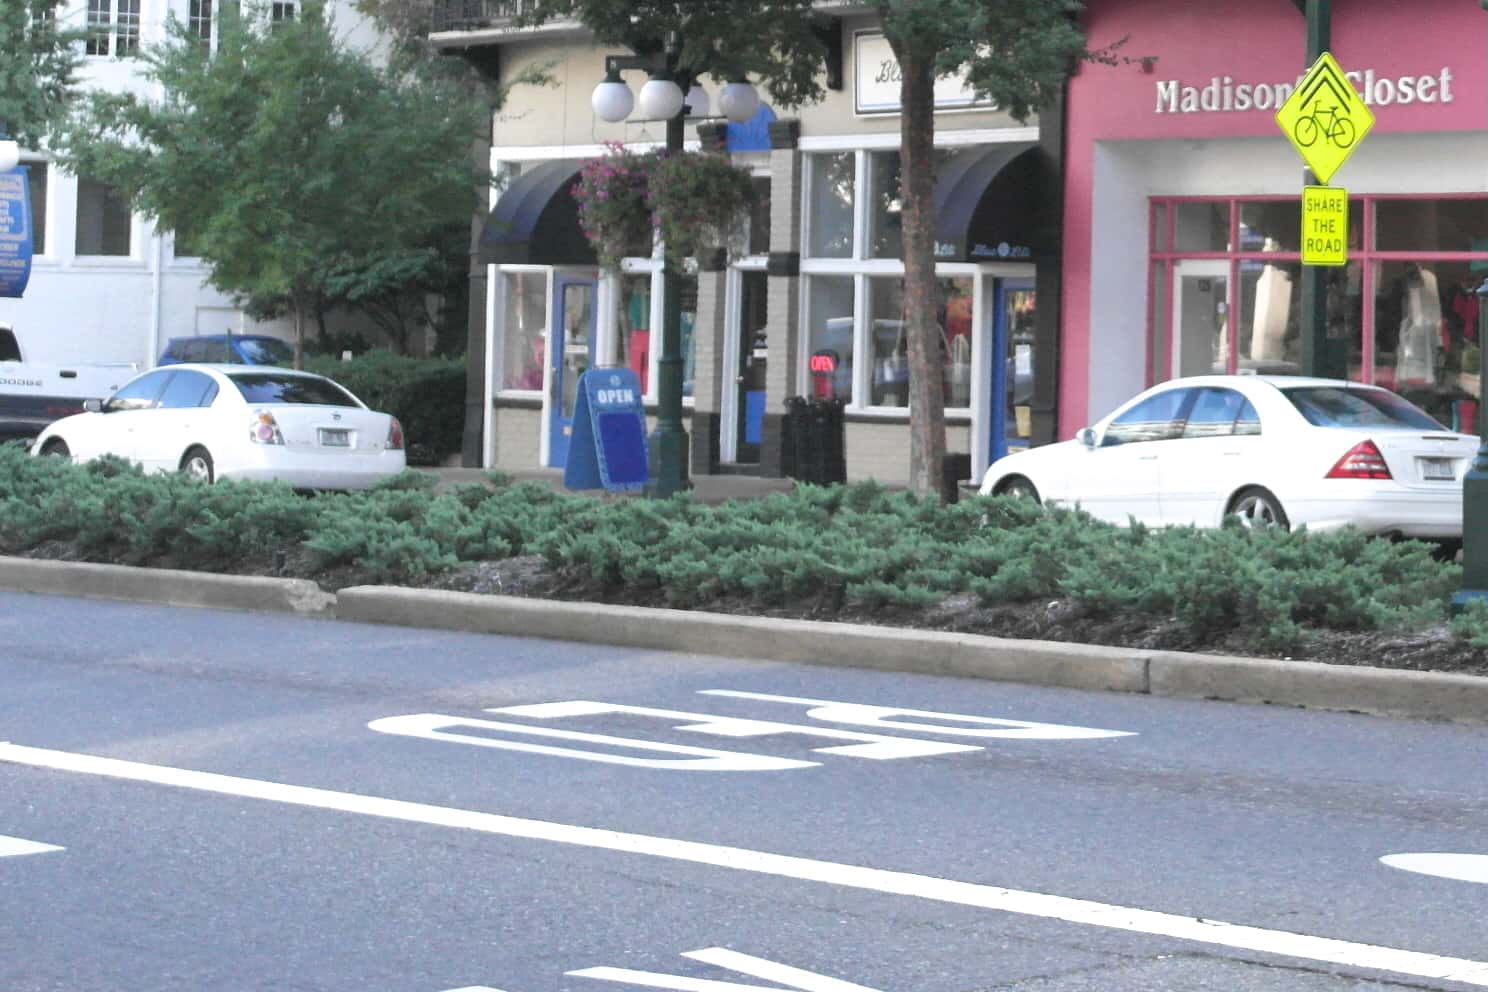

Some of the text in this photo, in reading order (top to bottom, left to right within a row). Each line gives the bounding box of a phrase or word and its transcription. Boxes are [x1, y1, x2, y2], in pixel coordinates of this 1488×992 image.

[1306, 197, 1343, 213] SHARE
[1312, 218, 1336, 234] THE
[1306, 238, 1342, 253] ROAD
[811, 354, 835, 372] OPEN
[597, 388, 635, 405] OPEN
